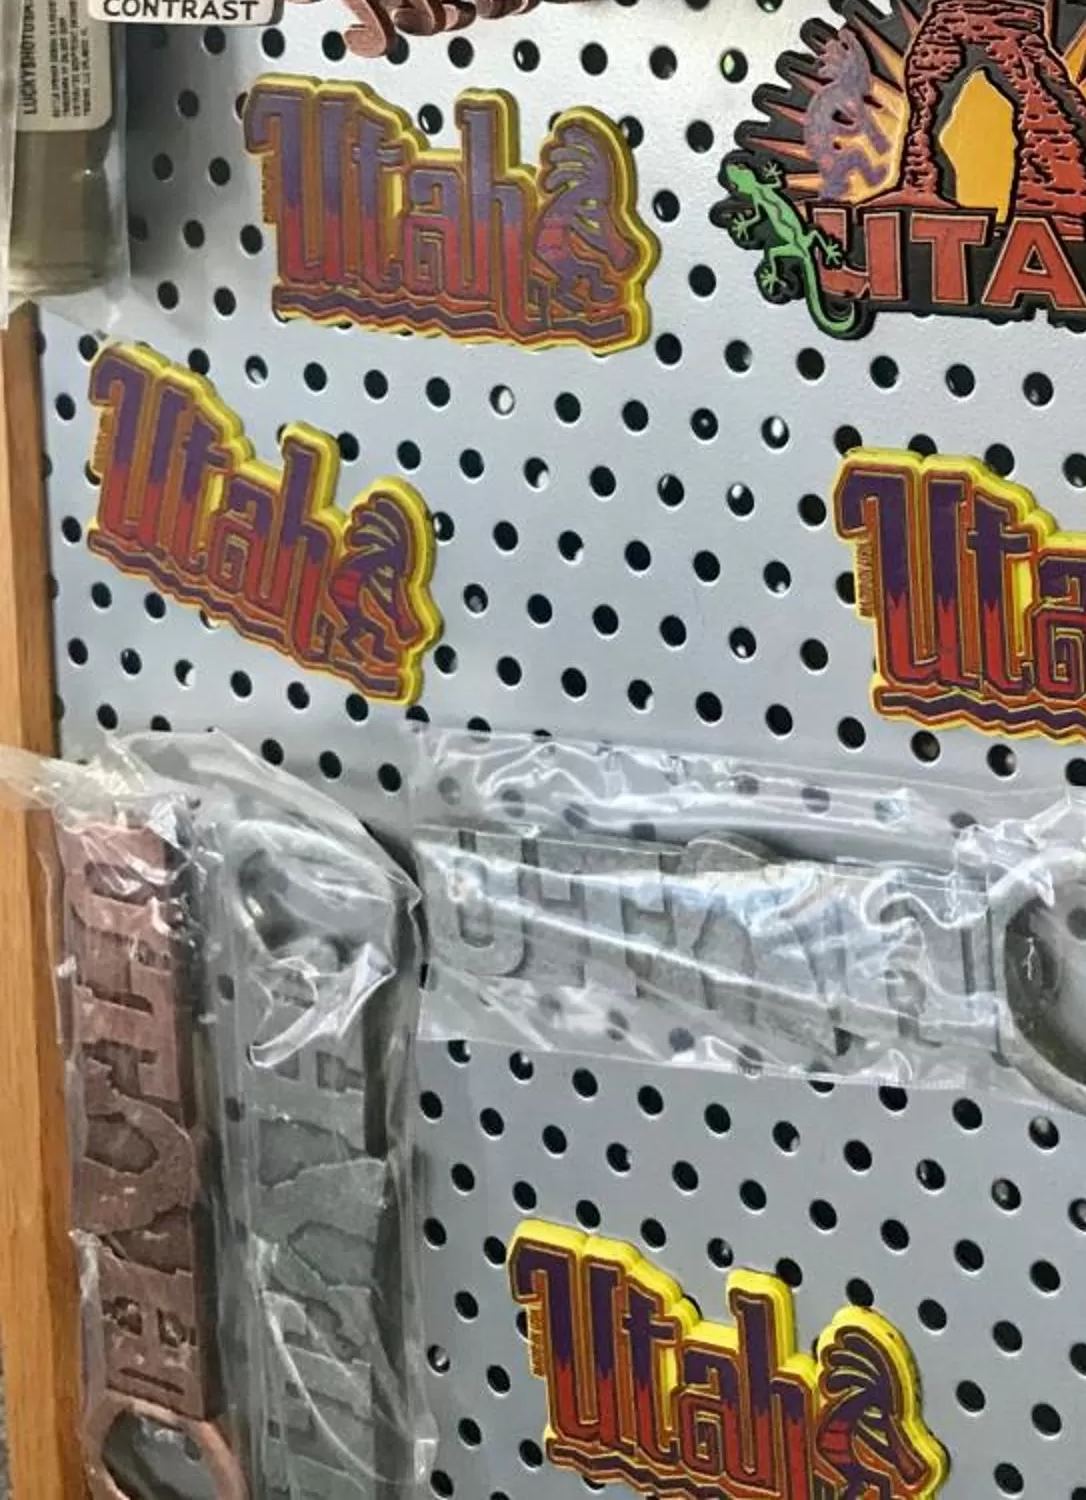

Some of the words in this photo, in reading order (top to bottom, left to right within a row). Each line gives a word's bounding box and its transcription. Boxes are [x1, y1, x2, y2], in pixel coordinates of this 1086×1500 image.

[245, 88, 535, 340] Utah
[90, 349, 338, 663] Utah
[508, 1235, 816, 1500] Utah
